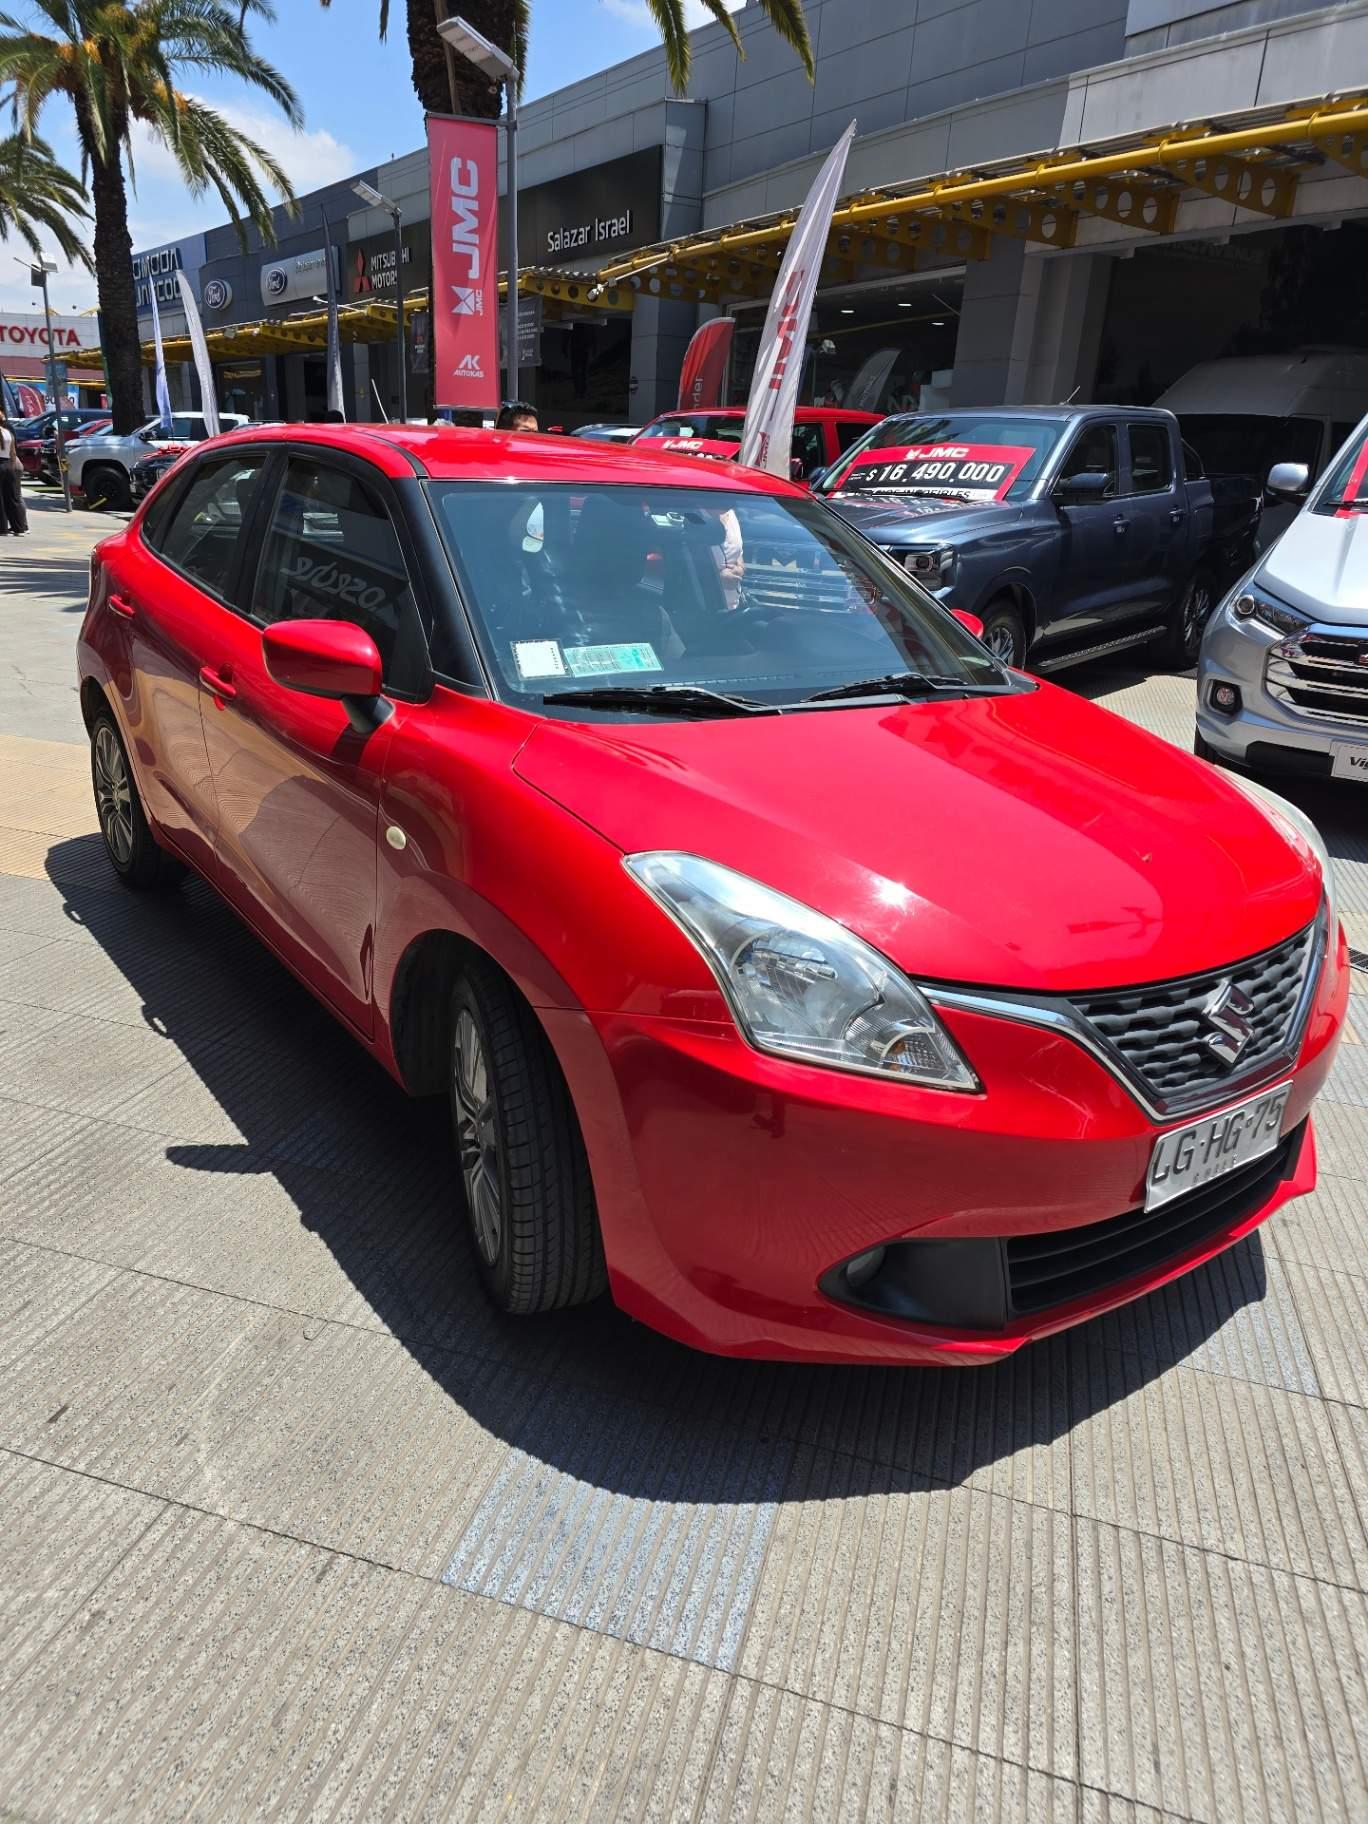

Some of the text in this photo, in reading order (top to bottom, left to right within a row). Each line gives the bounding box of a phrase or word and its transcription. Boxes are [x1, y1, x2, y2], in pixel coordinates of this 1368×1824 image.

[451, 156, 480, 280] JMC
[547, 209, 630, 252] Salazar Israel
[370, 247, 410, 272] MITSUBHI
[475, 288, 484, 317] JMC
[0, 325, 82, 347] TOYOTA
[458, 354, 481, 370] AK
[452, 369, 485, 379] AUTOKAS
[919, 447, 970, 458] JMC
